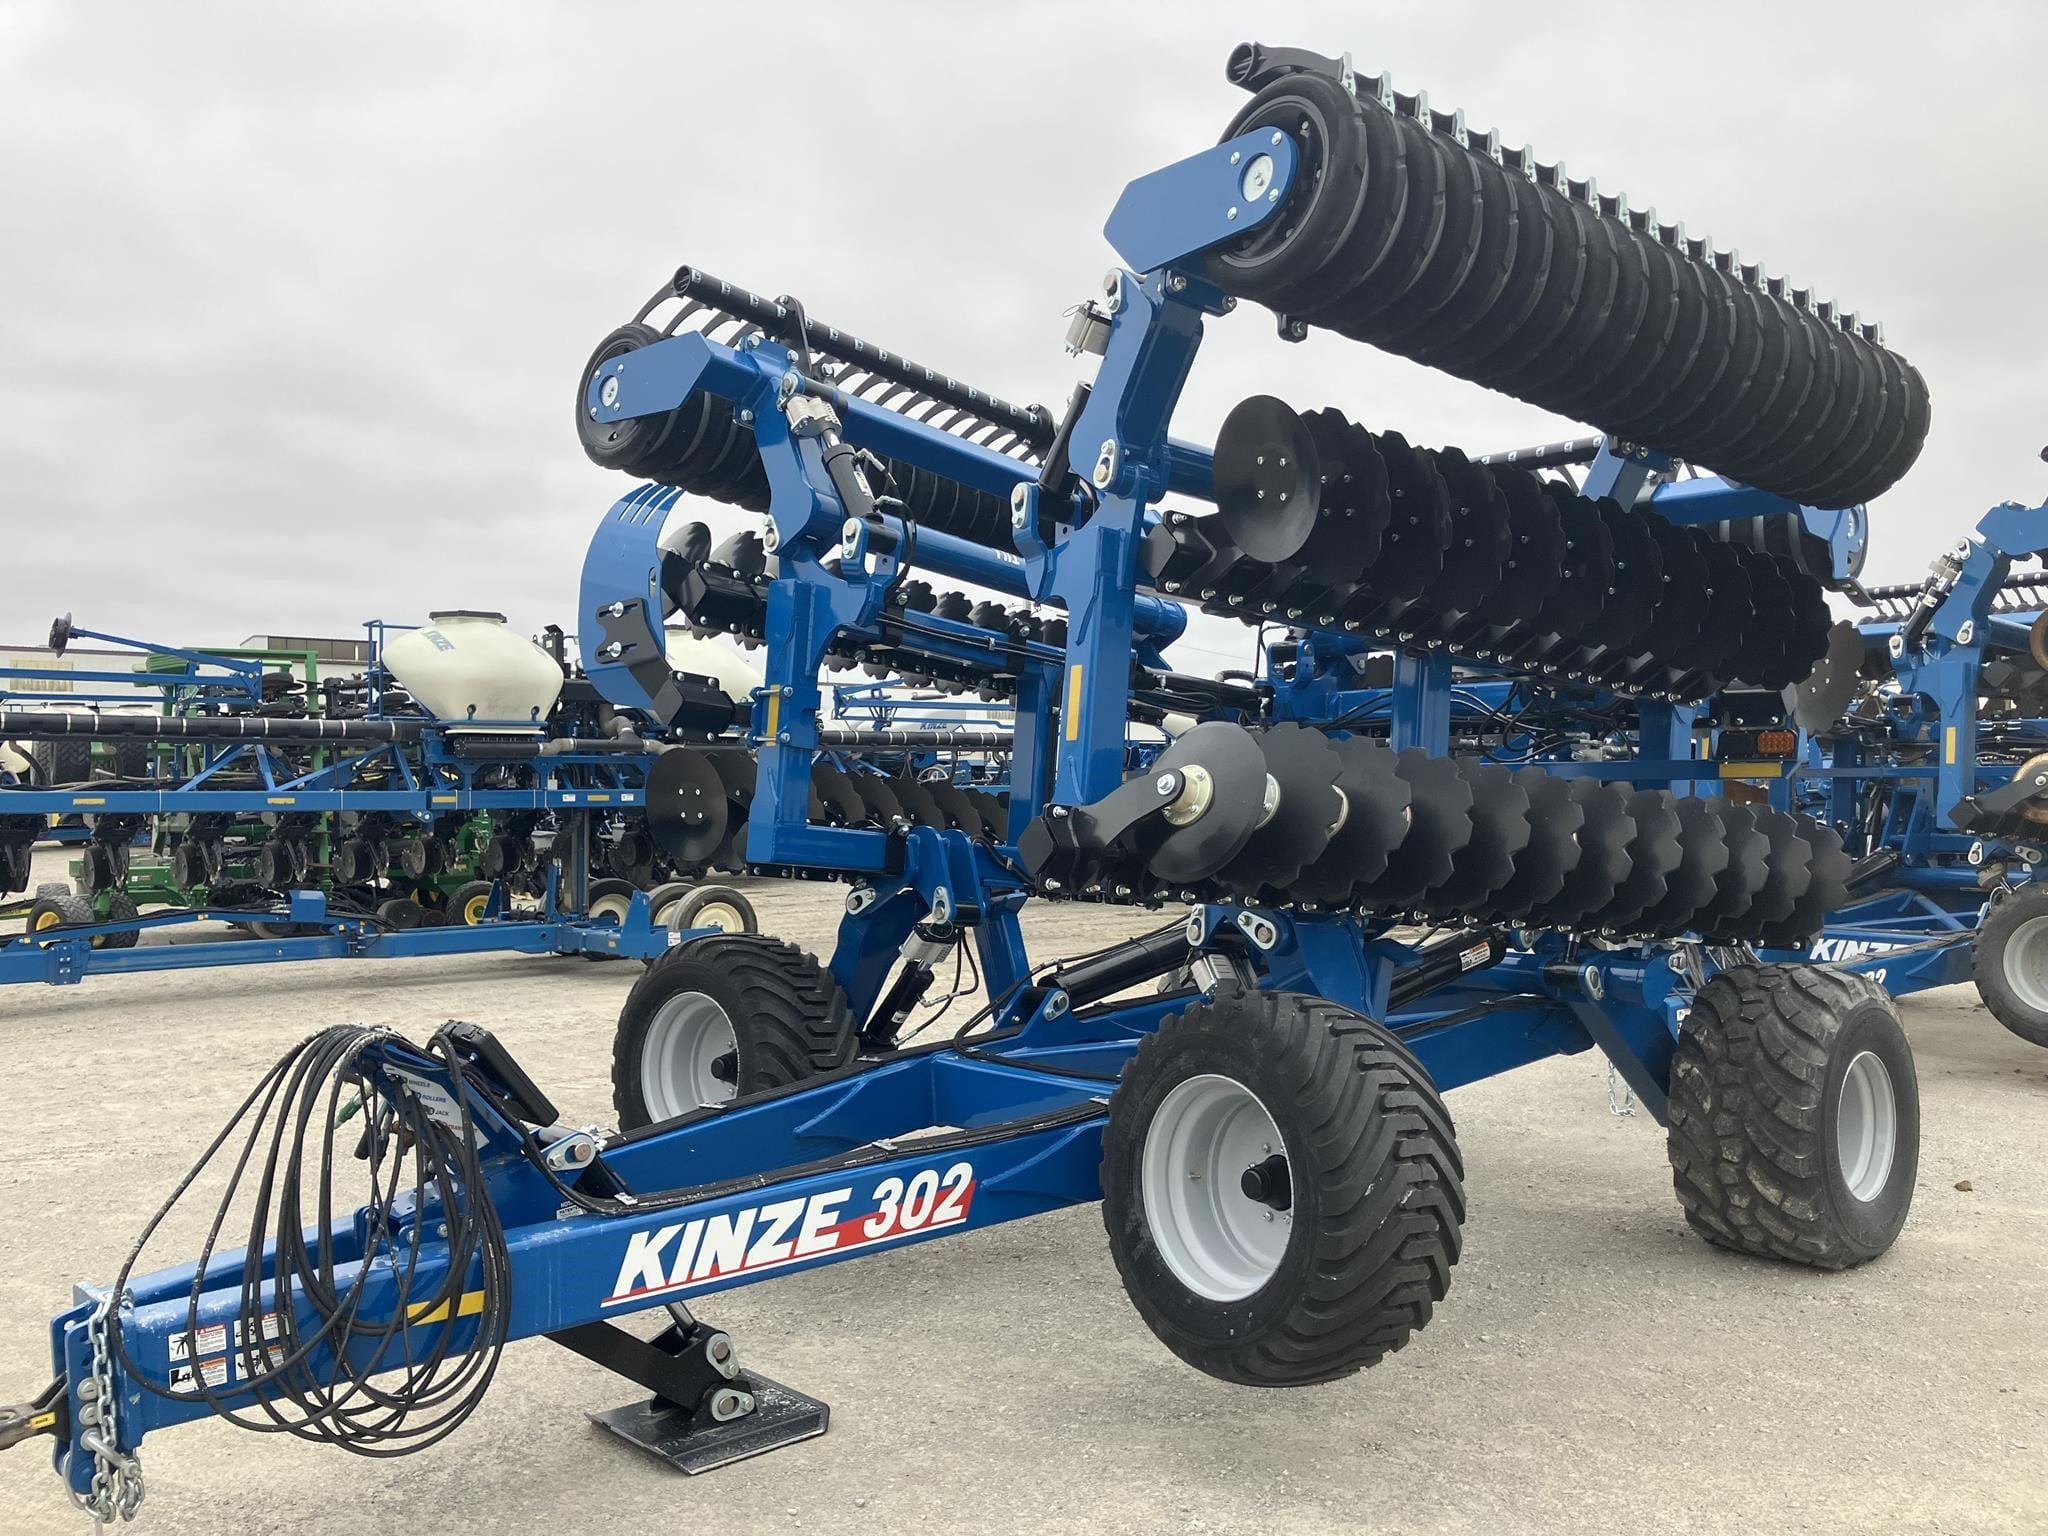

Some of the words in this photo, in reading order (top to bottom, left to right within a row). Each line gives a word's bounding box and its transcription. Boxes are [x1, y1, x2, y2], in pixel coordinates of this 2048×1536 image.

[422, 1094, 447, 1103] ROLLERS
[612, 1187, 852, 1298] KINZE
[863, 1162, 974, 1239] 302
